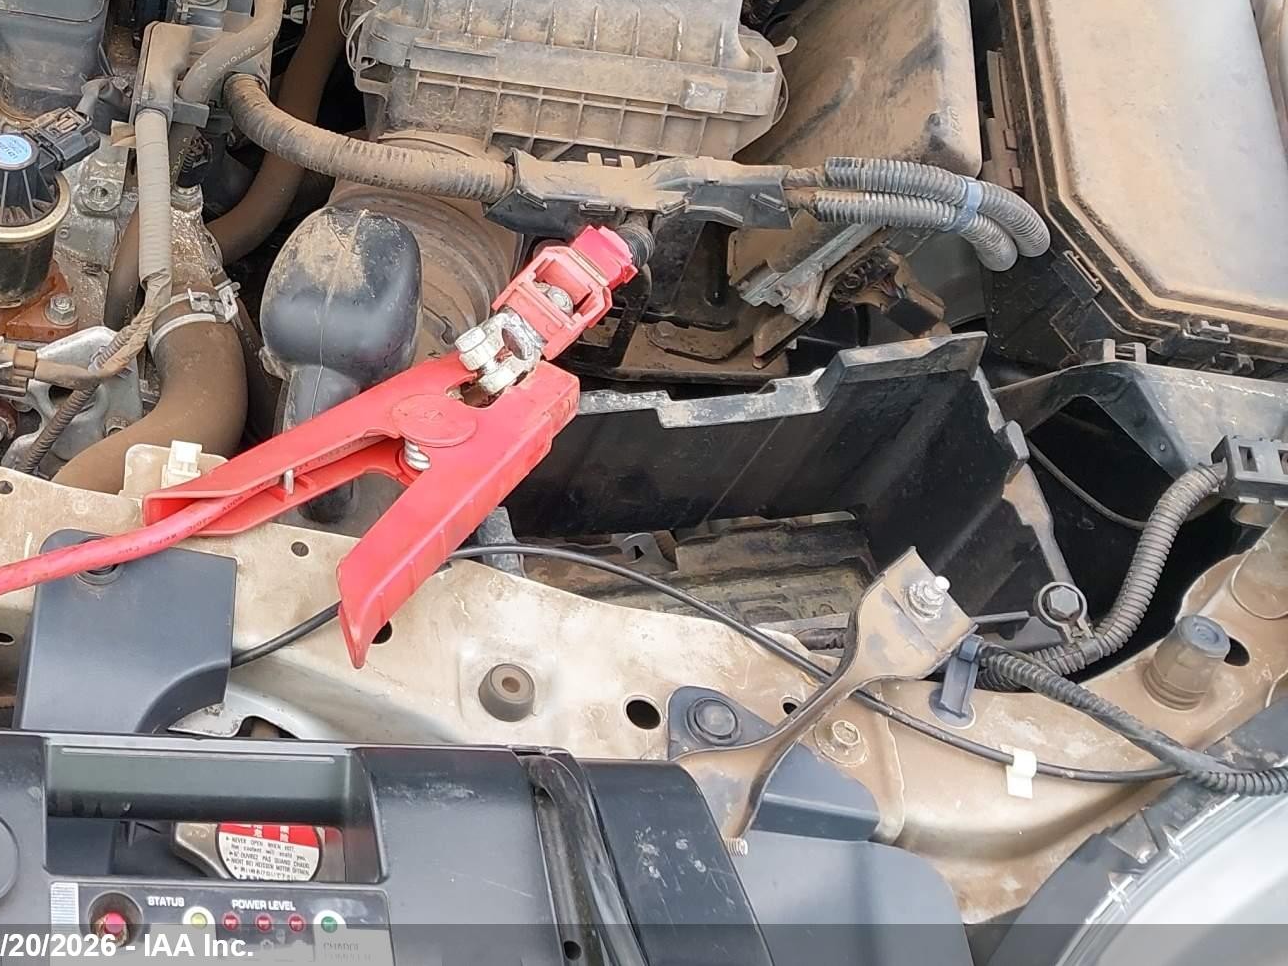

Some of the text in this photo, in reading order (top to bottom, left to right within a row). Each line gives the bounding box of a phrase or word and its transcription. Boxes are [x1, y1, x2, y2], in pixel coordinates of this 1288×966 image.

[262, 854, 271, 862] PAS
[147, 896, 185, 907] STATUS
[232, 899, 296, 912] POWER LEVEL
